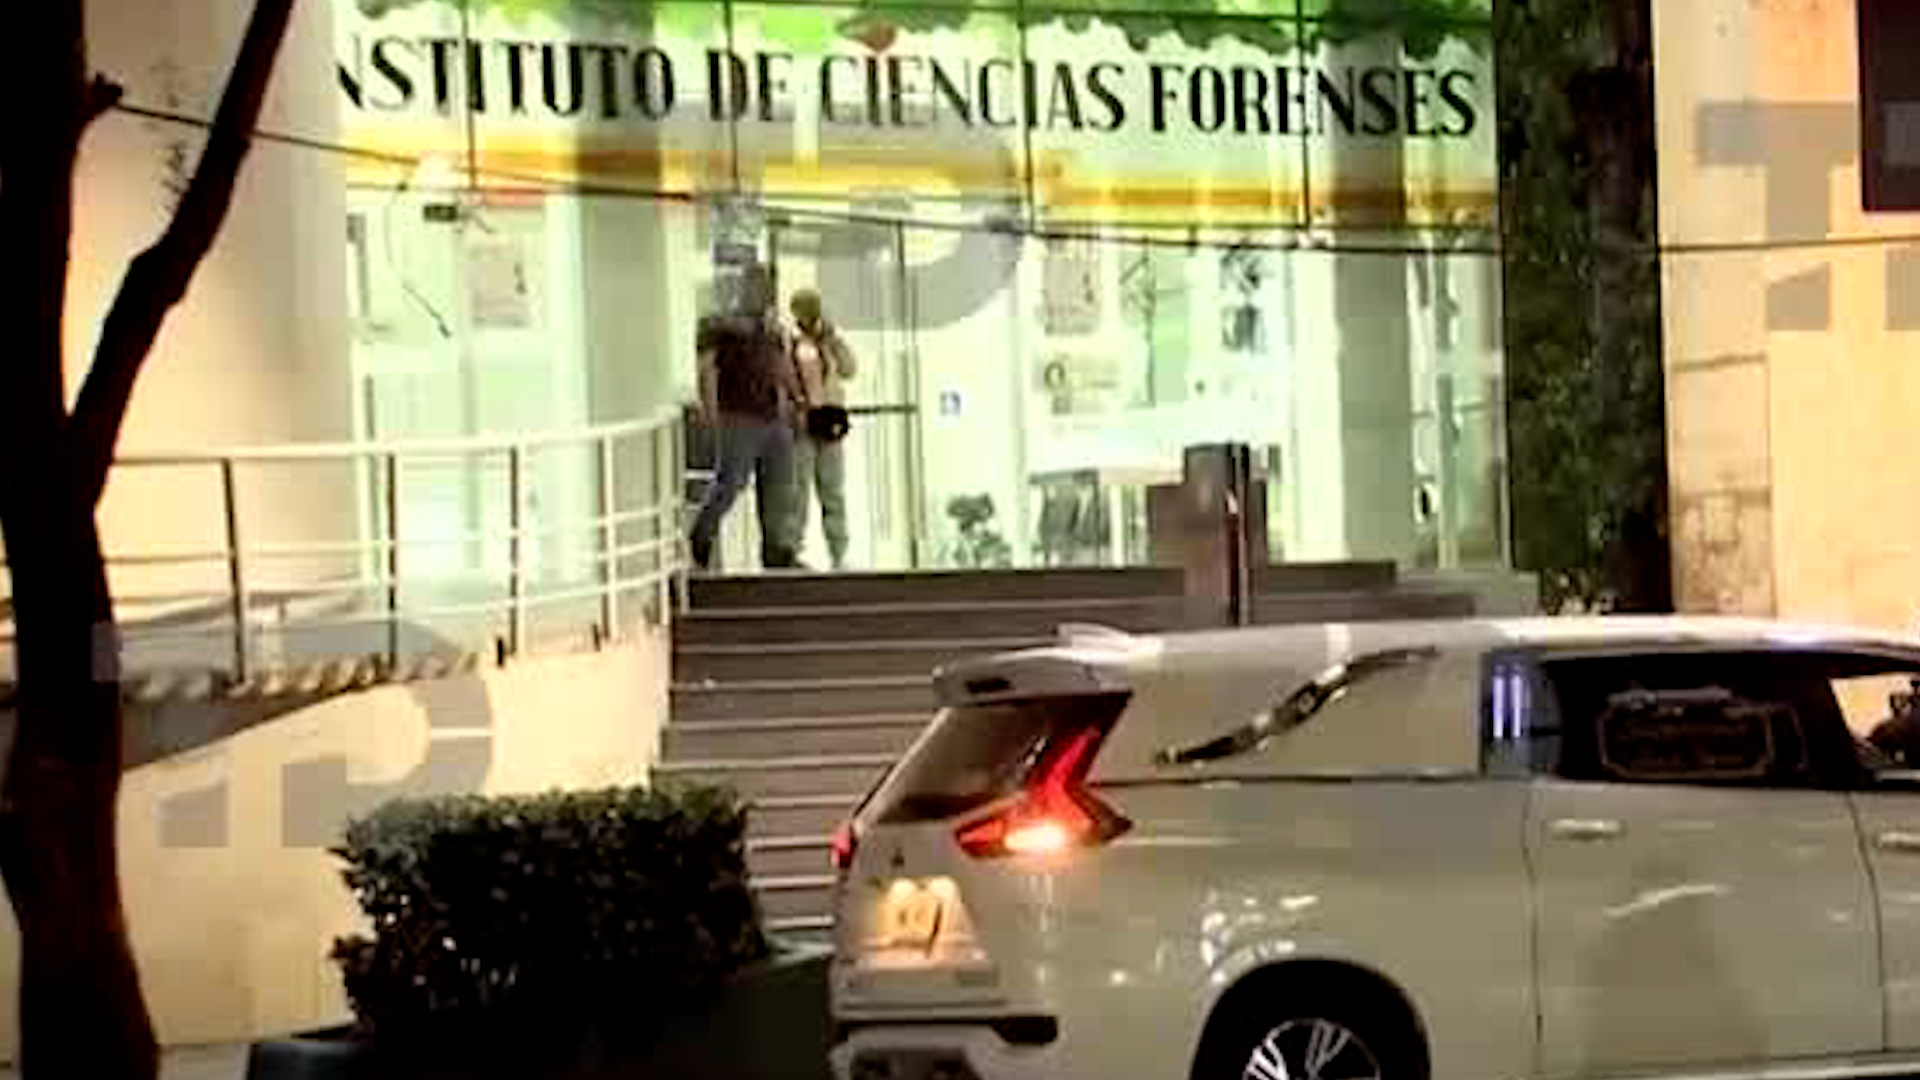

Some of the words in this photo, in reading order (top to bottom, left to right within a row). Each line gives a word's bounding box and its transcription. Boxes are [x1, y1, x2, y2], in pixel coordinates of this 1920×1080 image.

[706, 49, 795, 121] DE
[820, 55, 1125, 131] CIENCIAS
[1149, 64, 1476, 137] FORENSES
